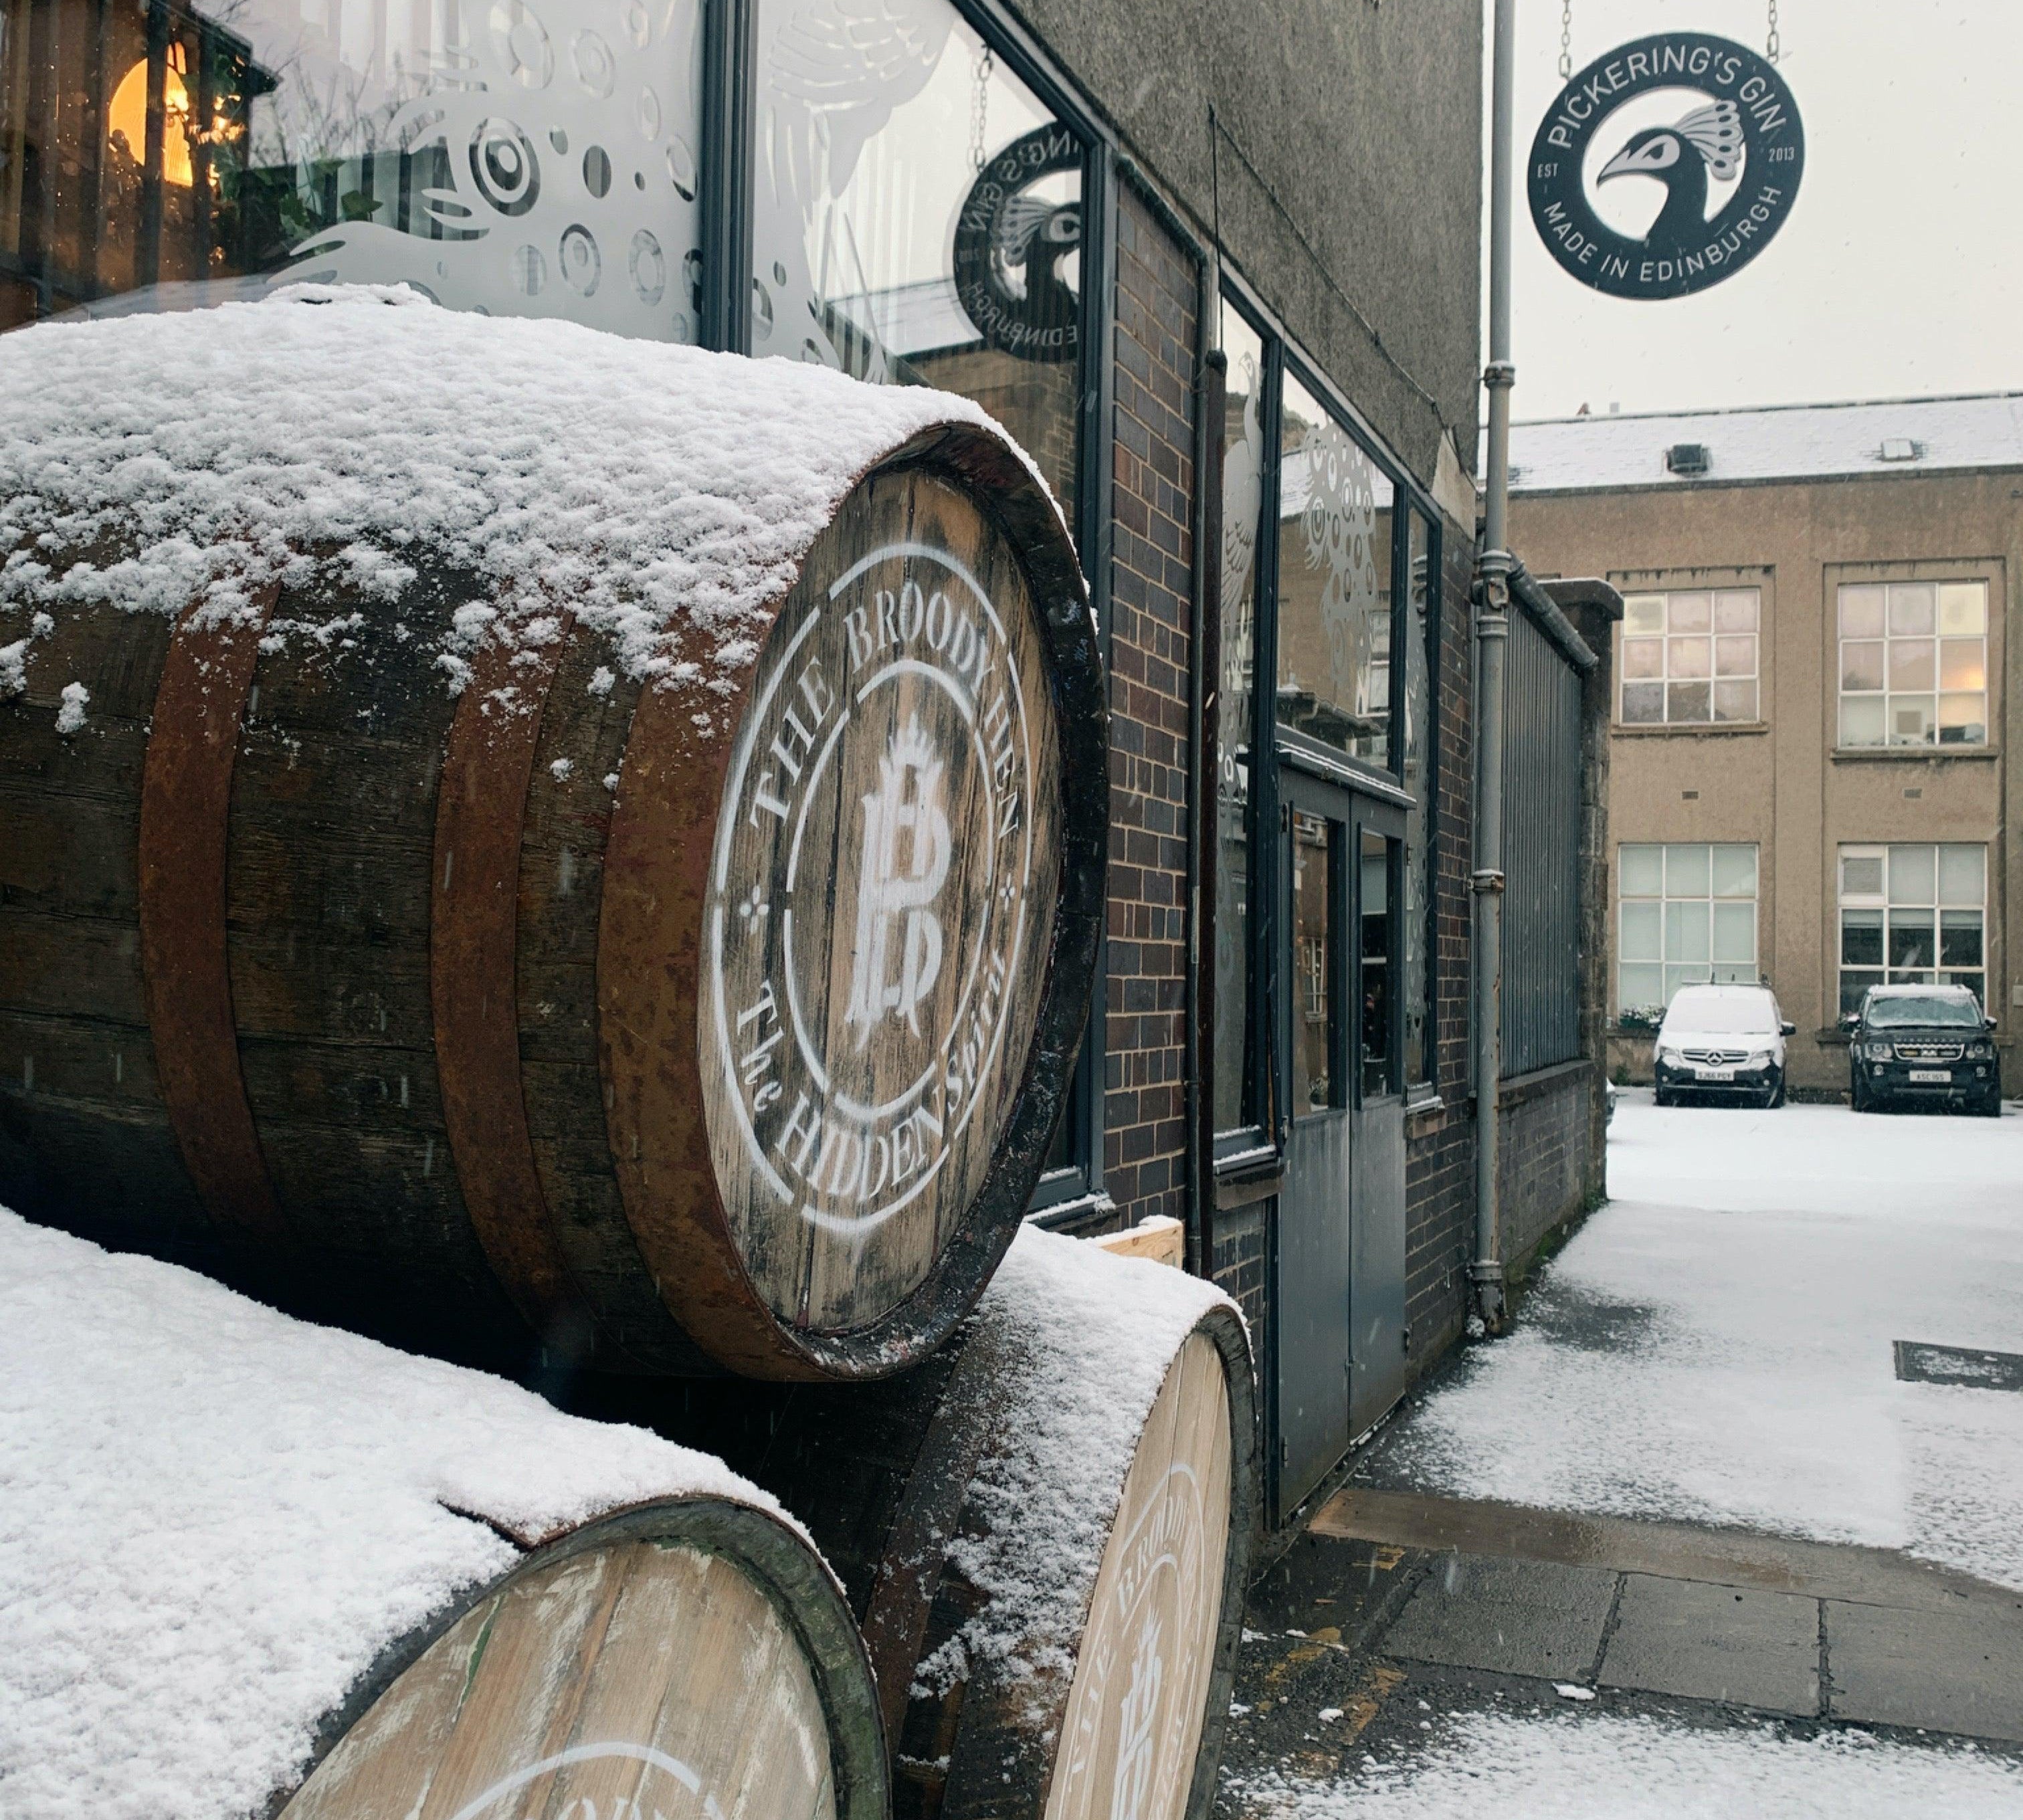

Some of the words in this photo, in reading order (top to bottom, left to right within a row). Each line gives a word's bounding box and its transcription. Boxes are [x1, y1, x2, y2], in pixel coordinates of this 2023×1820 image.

[1547, 45, 1742, 148] PICKERING'S
[1739, 76, 1786, 132] GIN
[1538, 164, 1558, 178] EST
[1769, 146, 1794, 163] 2013
[1544, 201, 1598, 264] MADE
[1600, 254, 1630, 278] IN
[1640, 186, 1781, 282] EDINBURGH
[749, 655, 836, 829] THE
[843, 578, 996, 700] BROODY
[983, 691, 1018, 839] HEN
[737, 980, 785, 1113] The
[774, 1084, 945, 1203] HIDDEN
